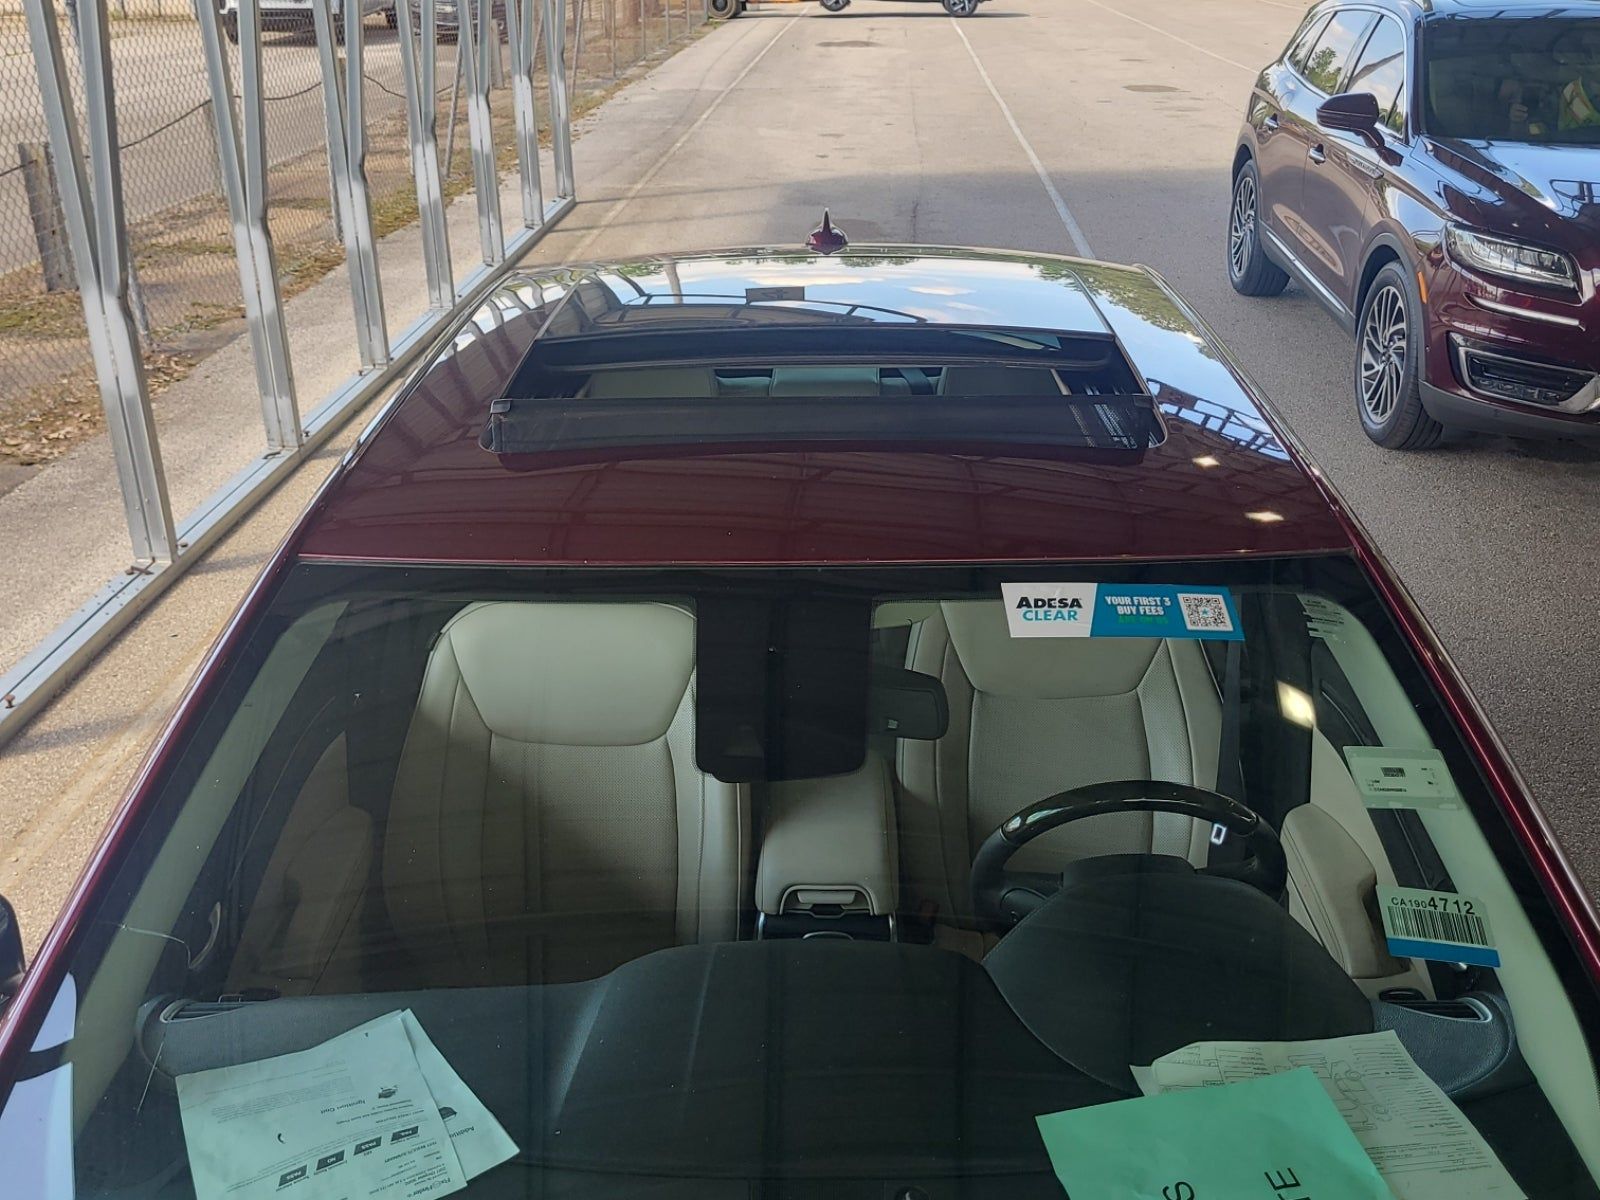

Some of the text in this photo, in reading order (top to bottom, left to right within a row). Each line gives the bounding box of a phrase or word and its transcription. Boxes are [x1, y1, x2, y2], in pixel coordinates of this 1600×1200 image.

[1016, 596, 1083, 609] ADESA
[1105, 596, 1171, 606] YOUR FIRST 3
[1022, 609, 1078, 621] CLEAR
[1117, 605, 1165, 615] BUY FEES
[1391, 896, 1475, 915] CA1904712
